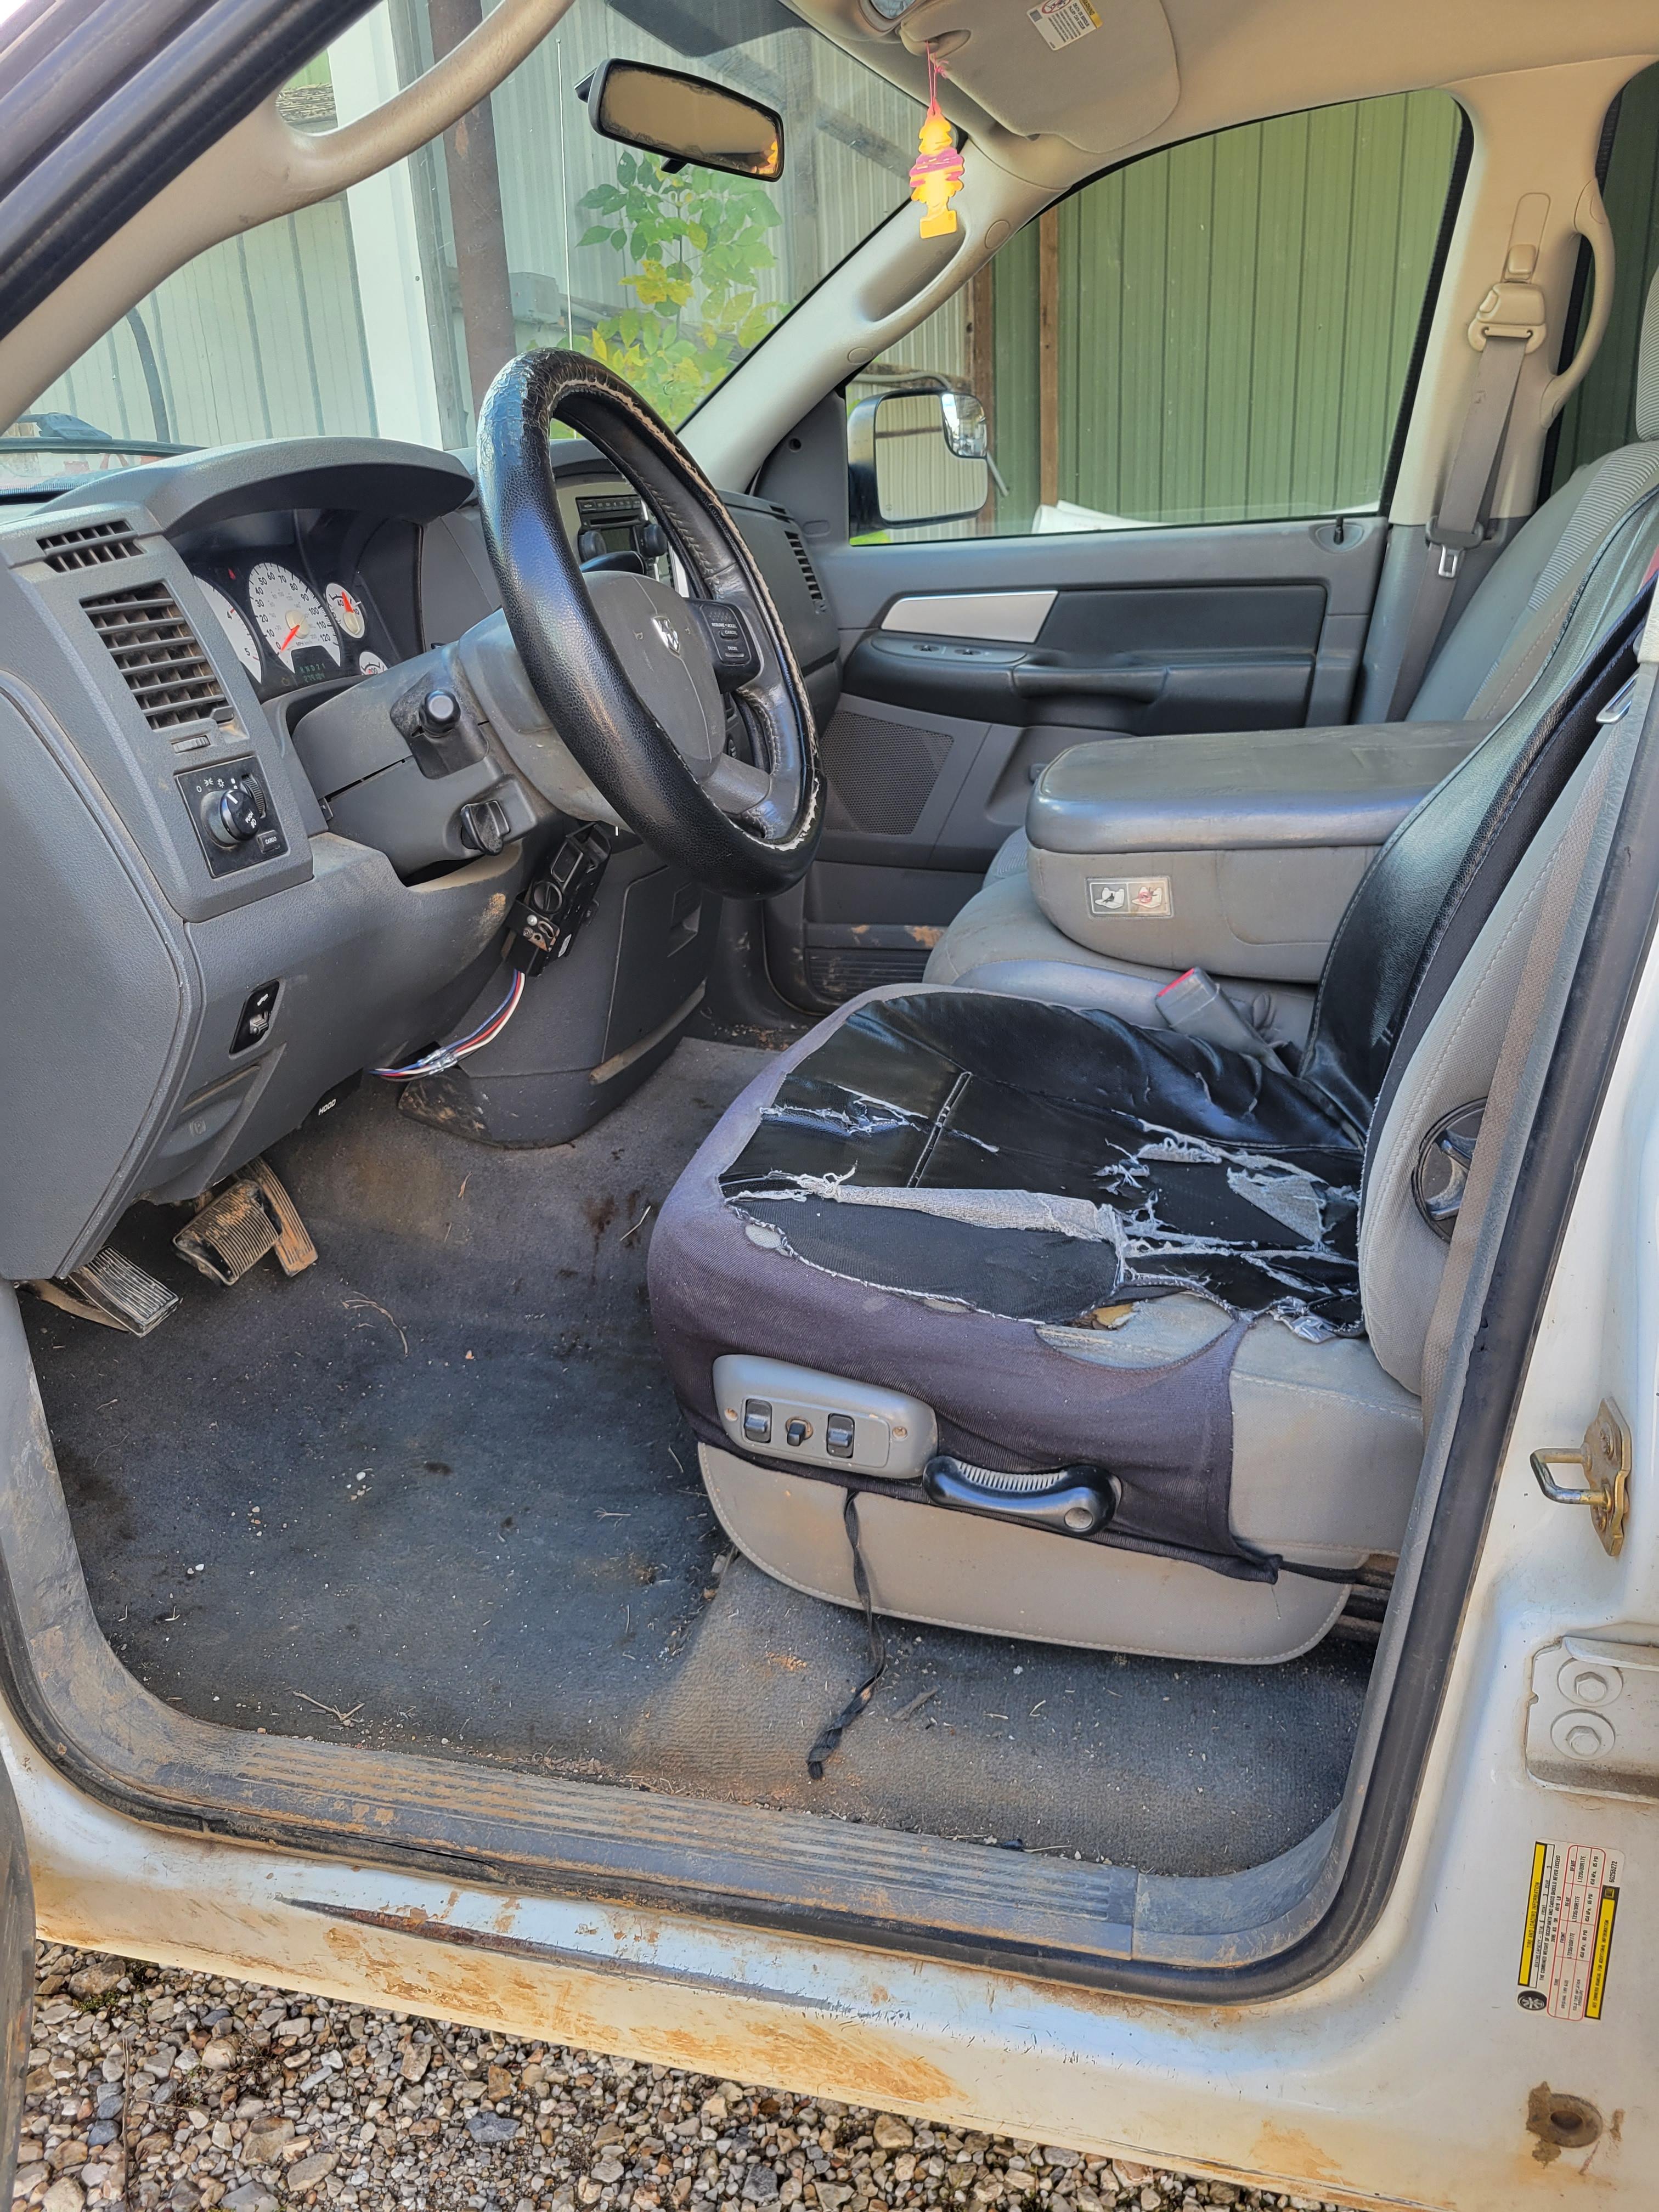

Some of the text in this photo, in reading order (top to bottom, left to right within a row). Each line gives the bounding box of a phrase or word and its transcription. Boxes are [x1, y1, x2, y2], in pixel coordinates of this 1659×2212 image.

[267, 572, 275, 580] 60
[278, 575, 287, 583] 70
[258, 577, 267, 585] 50
[255, 586, 264, 595] 40
[290, 583, 298, 591] 80
[301, 593, 309, 602] 90
[255, 599, 264, 608] 30
[227, 611, 232, 619] 4
[308, 607, 319, 616] 100
[259, 614, 268, 623] 20
[317, 621, 326, 629] 110
[267, 629, 274, 637] 10
[320, 634, 331, 642] 120
[275, 641, 281, 650] 0
[245, 811, 254, 823] PUSH
[265, 836, 276, 845] CARGO
[318, 1098, 336, 1116] HOOD
[1531, 1881, 1540, 1910] INFORMATION
